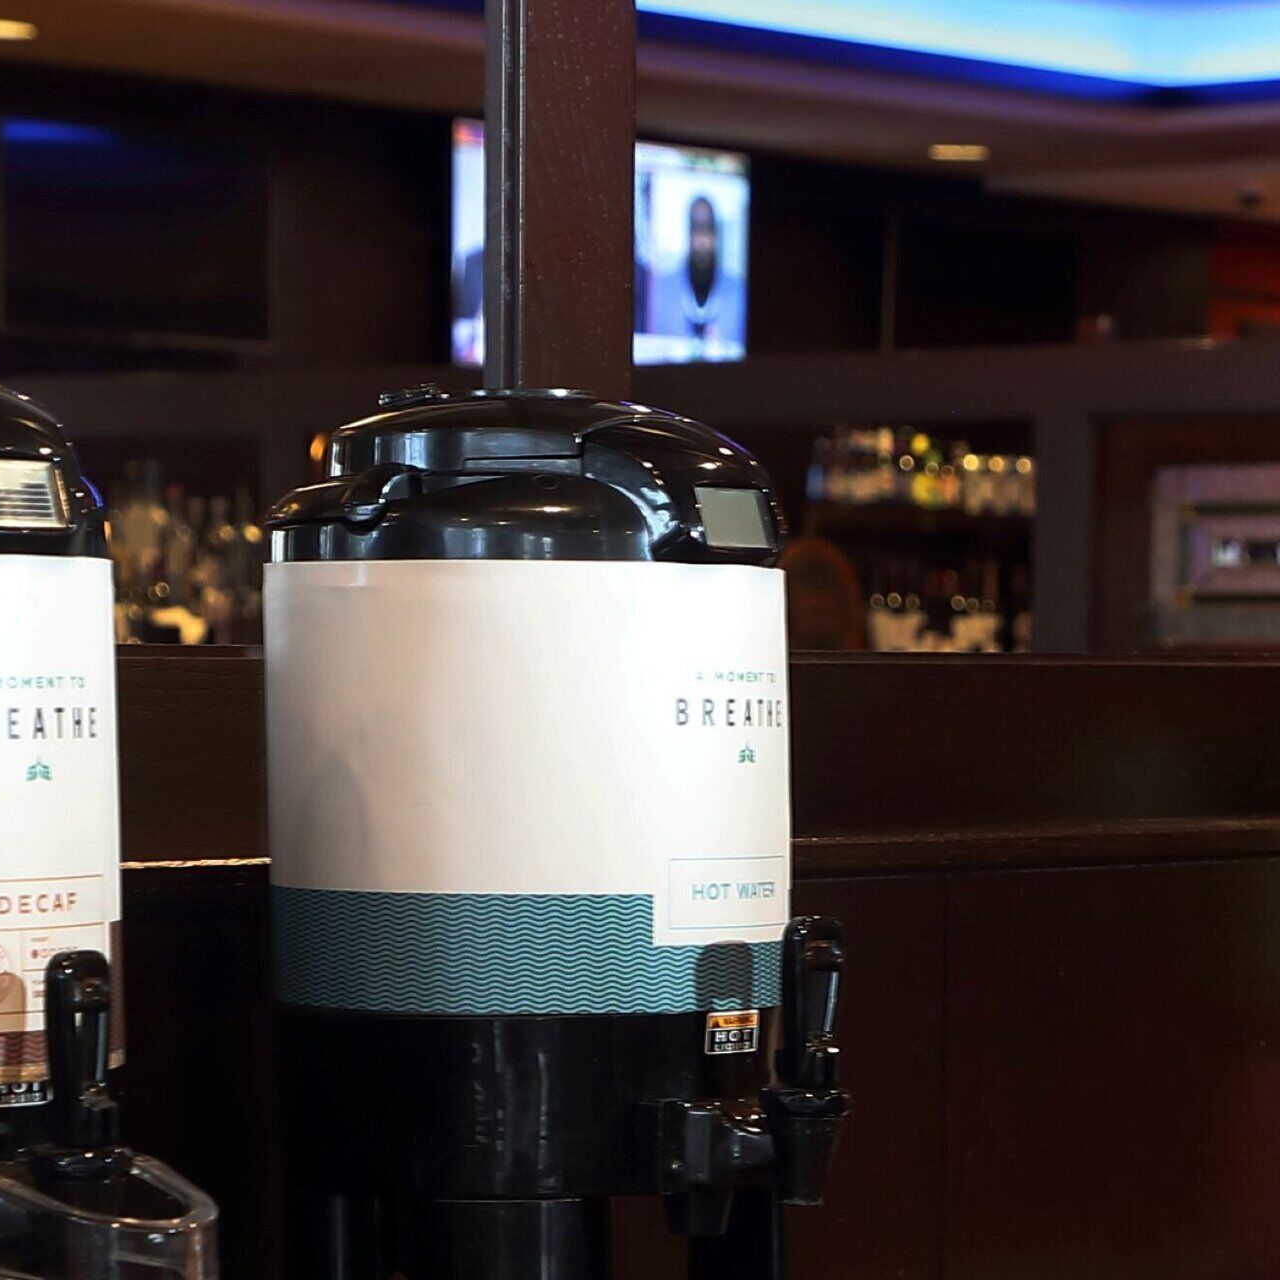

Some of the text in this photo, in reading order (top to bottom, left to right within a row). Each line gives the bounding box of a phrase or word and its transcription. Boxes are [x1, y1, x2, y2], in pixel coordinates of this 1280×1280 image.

[70, 676, 86, 689] TO
[714, 671, 764, 683] MOMENT
[675, 698, 782, 728] BREATHE
[691, 881, 776, 900] HOT WATER
[714, 1028, 752, 1043] HOT
